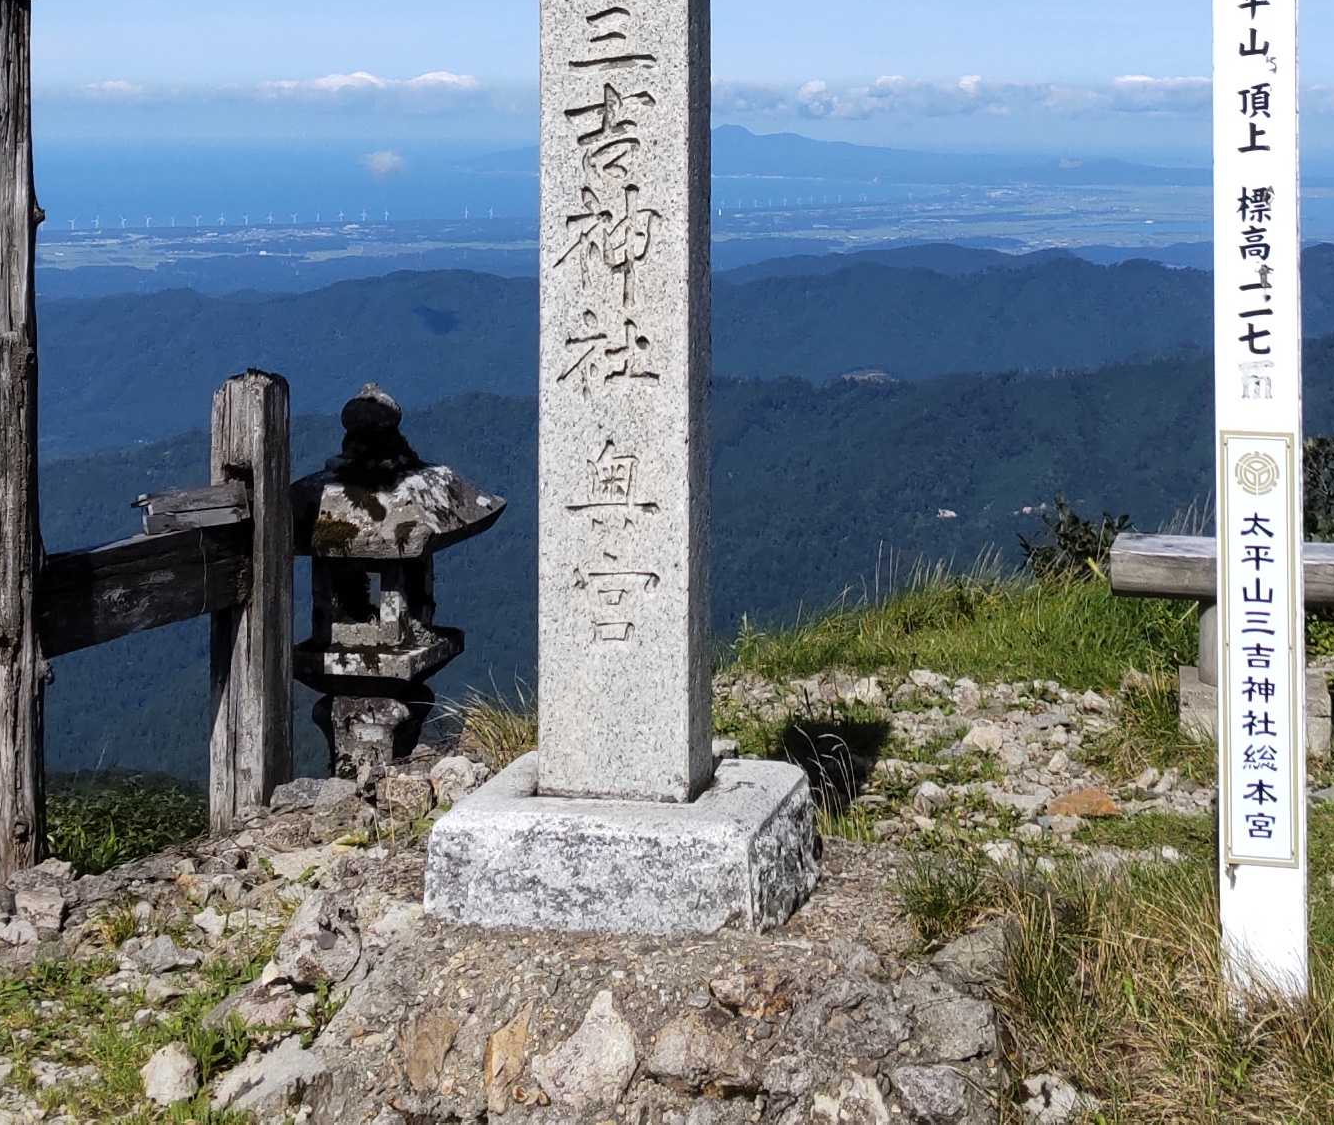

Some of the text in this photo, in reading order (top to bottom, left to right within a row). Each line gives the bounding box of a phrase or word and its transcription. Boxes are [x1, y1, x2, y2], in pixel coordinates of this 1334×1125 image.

[1237, 82, 1271, 153] 頂上
[1240, 512, 1278, 839] 太平山三吉神社総本宮
